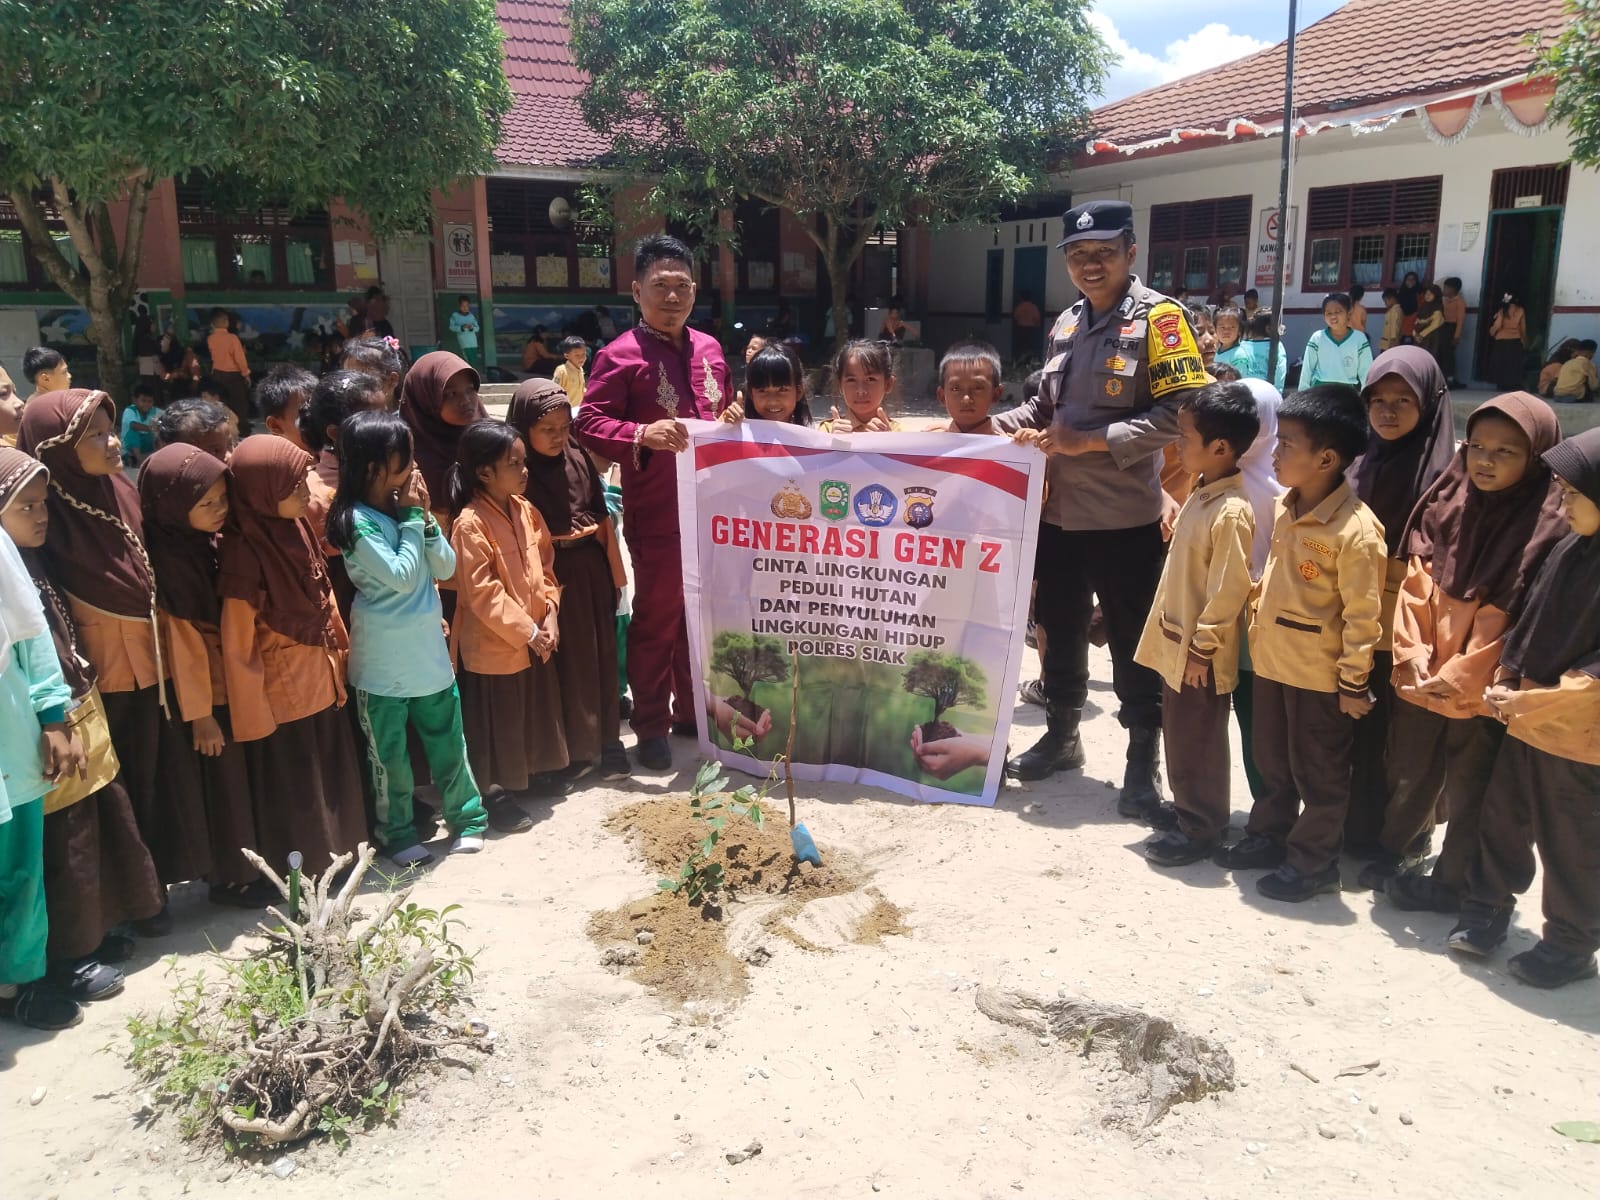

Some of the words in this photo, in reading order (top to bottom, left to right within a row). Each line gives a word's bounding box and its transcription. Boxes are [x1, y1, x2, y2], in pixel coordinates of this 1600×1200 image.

[448, 268, 476, 276] BULLYIN
[1104, 337, 1140, 351] POLRI
[711, 514, 880, 560] GENERASI
[893, 532, 966, 571] GEN
[978, 543, 1003, 573] Z
[752, 557, 808, 576] CINTA
[815, 561, 947, 589] LINGKUNGAN
[779, 579, 844, 599] PEDULI
[851, 587, 917, 606] HUTAN
[759, 598, 800, 614] DAN
[808, 604, 937, 629] PENYULUHAN
[751, 618, 878, 642] LINGKUNGAN
[884, 631, 946, 650] HIDUP
[788, 640, 856, 658] POLRES
[862, 647, 906, 666] SIAK
